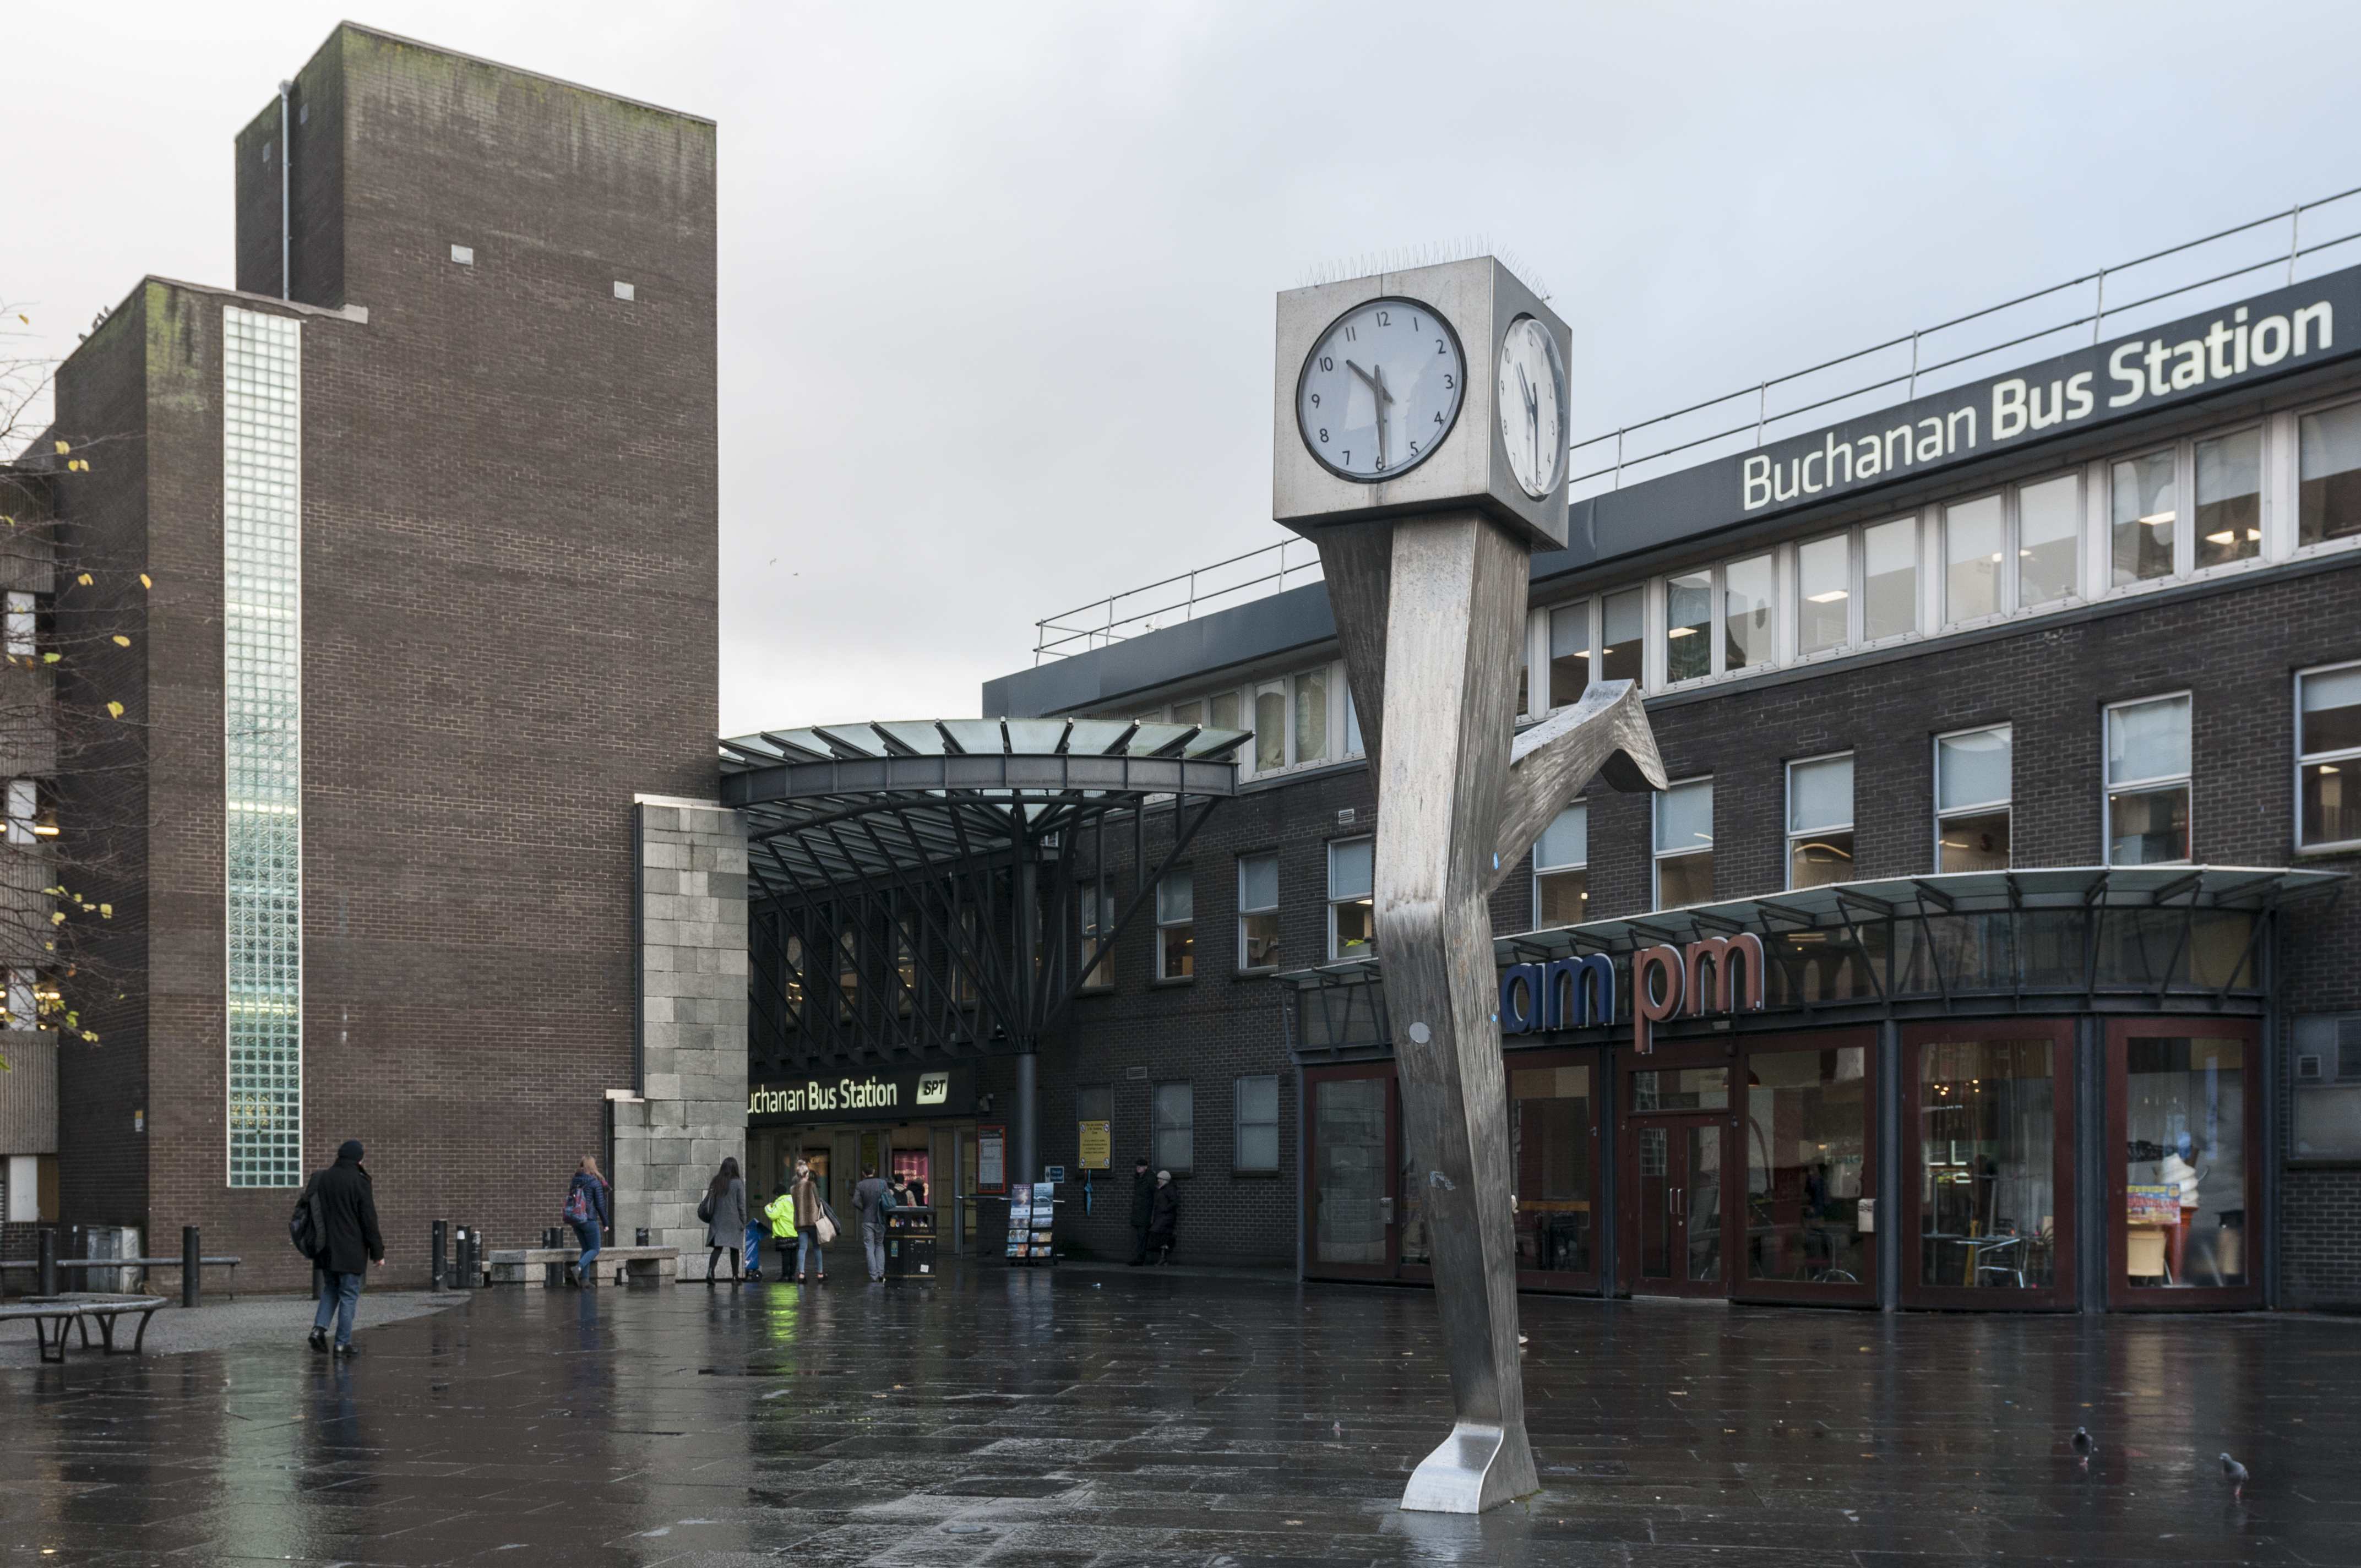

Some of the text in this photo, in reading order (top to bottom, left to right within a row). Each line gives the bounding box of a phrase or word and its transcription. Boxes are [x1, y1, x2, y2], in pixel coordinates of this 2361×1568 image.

[1377, 311, 1391, 327] 12
[1413, 317, 1418, 332] 1
[1345, 326, 1356, 342] 11
[1527, 328, 1533, 347] 12
[1435, 339, 1446, 355] 2
[1504, 346, 1510, 364] 10
[1319, 356, 1334, 372] 10
[1444, 374, 1454, 389] 3
[1500, 380, 1505, 396] 9
[1549, 383, 1553, 400] 2
[1311, 394, 1320, 409] 9
[1743, 300, 2333, 512] Buchanan Bus Station
[1434, 411, 1444, 425] 4
[1319, 428, 1329, 443] 8
[1504, 420, 1508, 435] 8
[1552, 420, 1555, 435] 3
[1410, 441, 1419, 456] 5
[1342, 450, 1351, 465] 7
[1375, 456, 1386, 471] 6
[1513, 452, 1516, 468] 7
[1547, 453, 1552, 467] 4
[1525, 476, 1529, 487] 6
[1538, 471, 1542, 487] 5
[1500, 932, 1765, 1054] am pm
[747, 1076, 897, 1113] uchanan Bus Station
[923, 1079, 946, 1096] SPT
